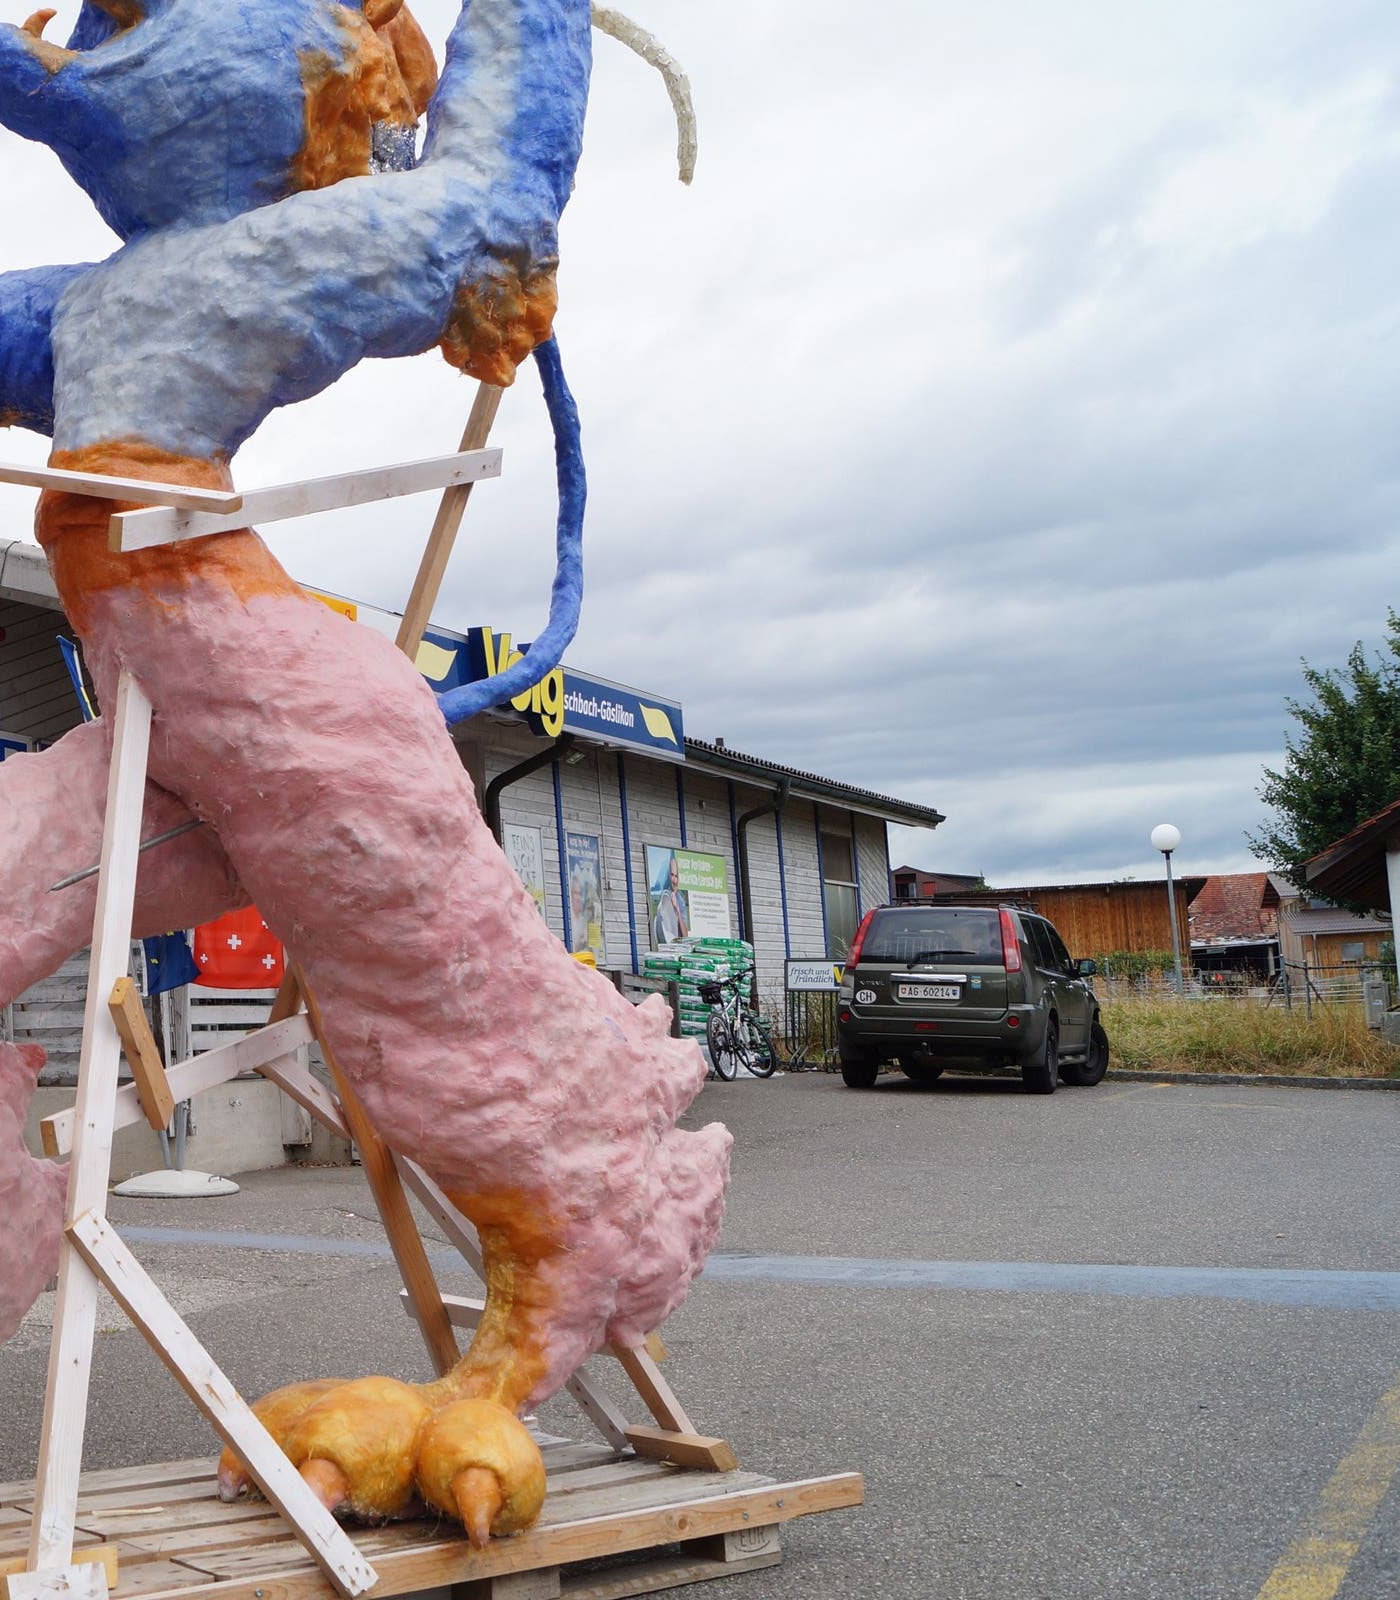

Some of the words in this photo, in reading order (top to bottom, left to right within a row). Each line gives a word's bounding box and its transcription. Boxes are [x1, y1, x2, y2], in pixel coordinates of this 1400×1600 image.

[789, 967, 814, 977] frisch
[815, 968, 830, 976] und
[859, 991, 872, 1002] CH
[908, 987, 918, 996] AG
[923, 986, 950, 998] 60214
